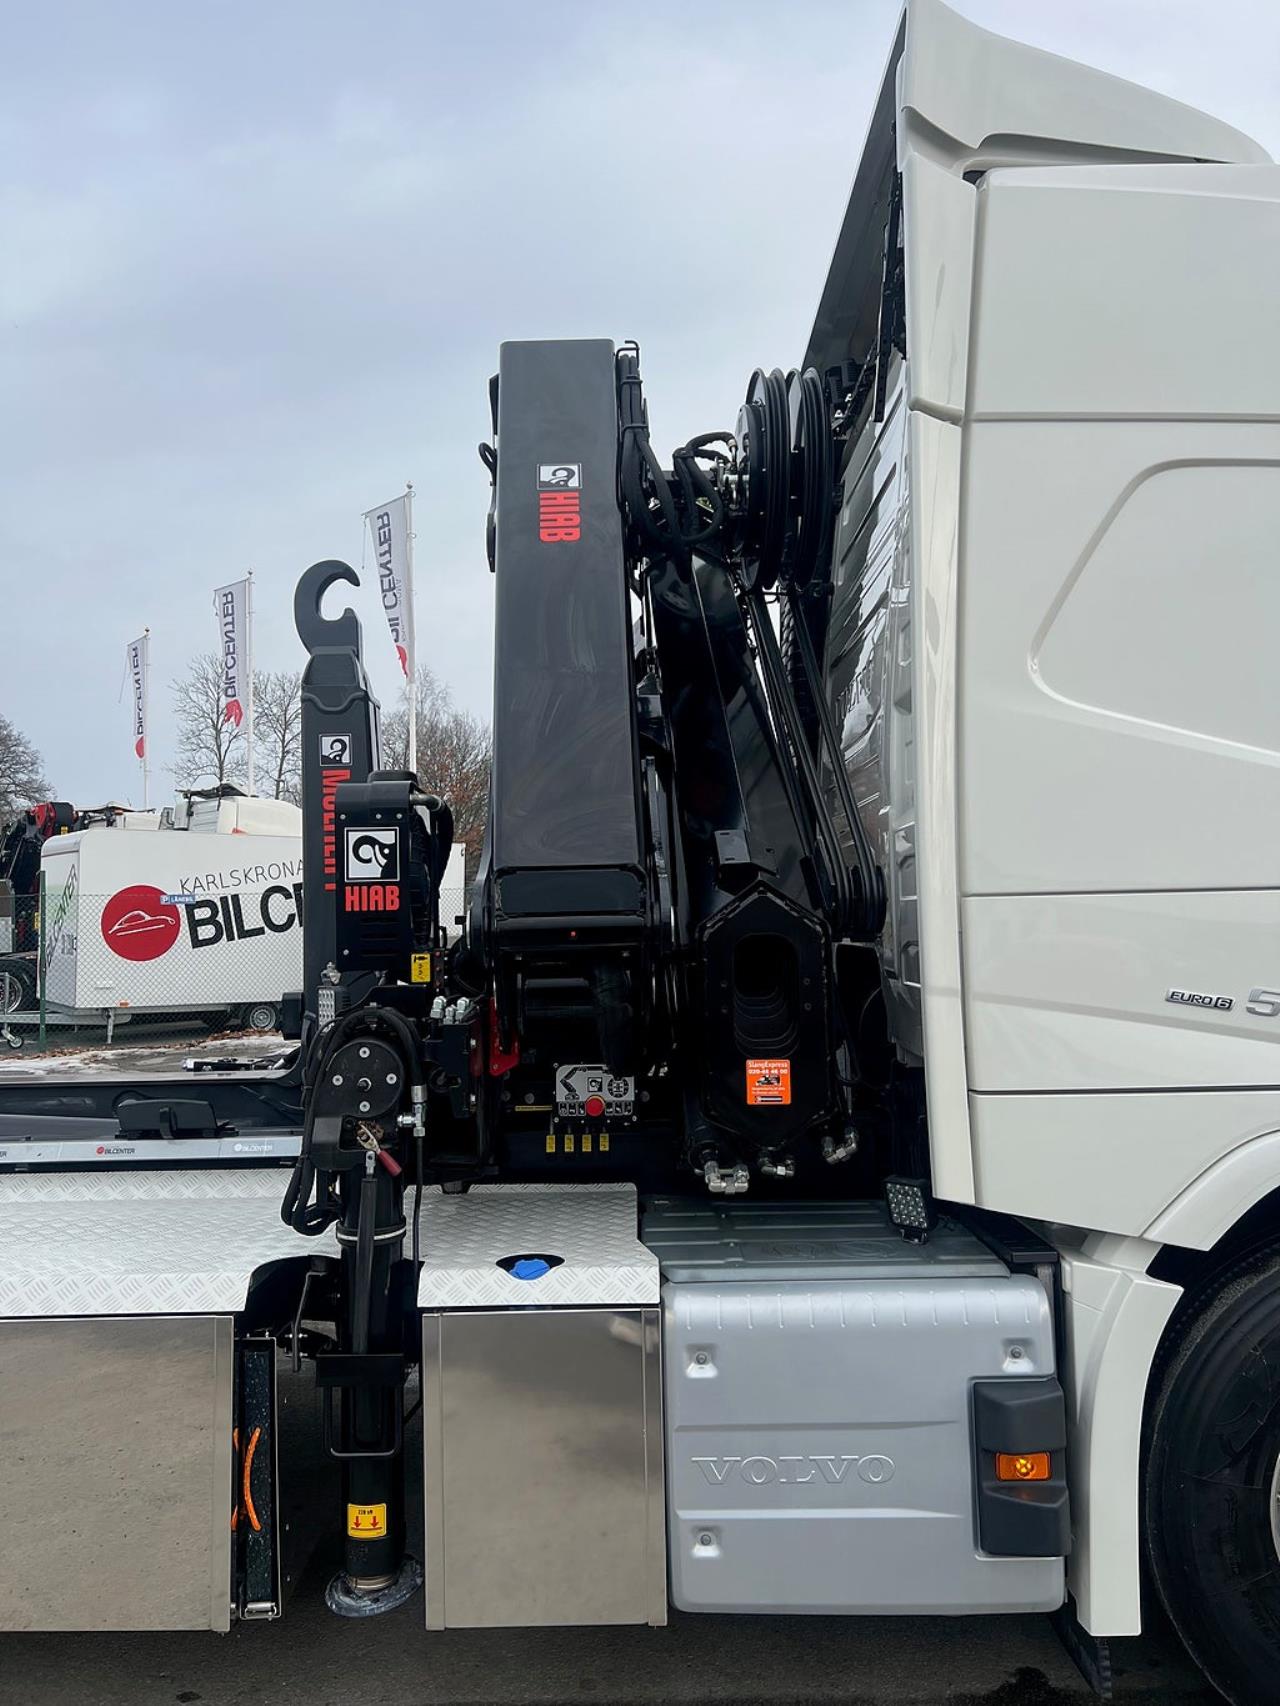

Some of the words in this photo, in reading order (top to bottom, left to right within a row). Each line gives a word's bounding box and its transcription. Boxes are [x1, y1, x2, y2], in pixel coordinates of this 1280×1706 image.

[539, 491, 581, 542] HIAB
[180, 859, 304, 895] KARLSKRONA
[345, 885, 400, 912] HIAB
[1170, 991, 1213, 1005] EURO
[1215, 996, 1233, 1010] 6
[691, 1455, 896, 1486] VOLVO
